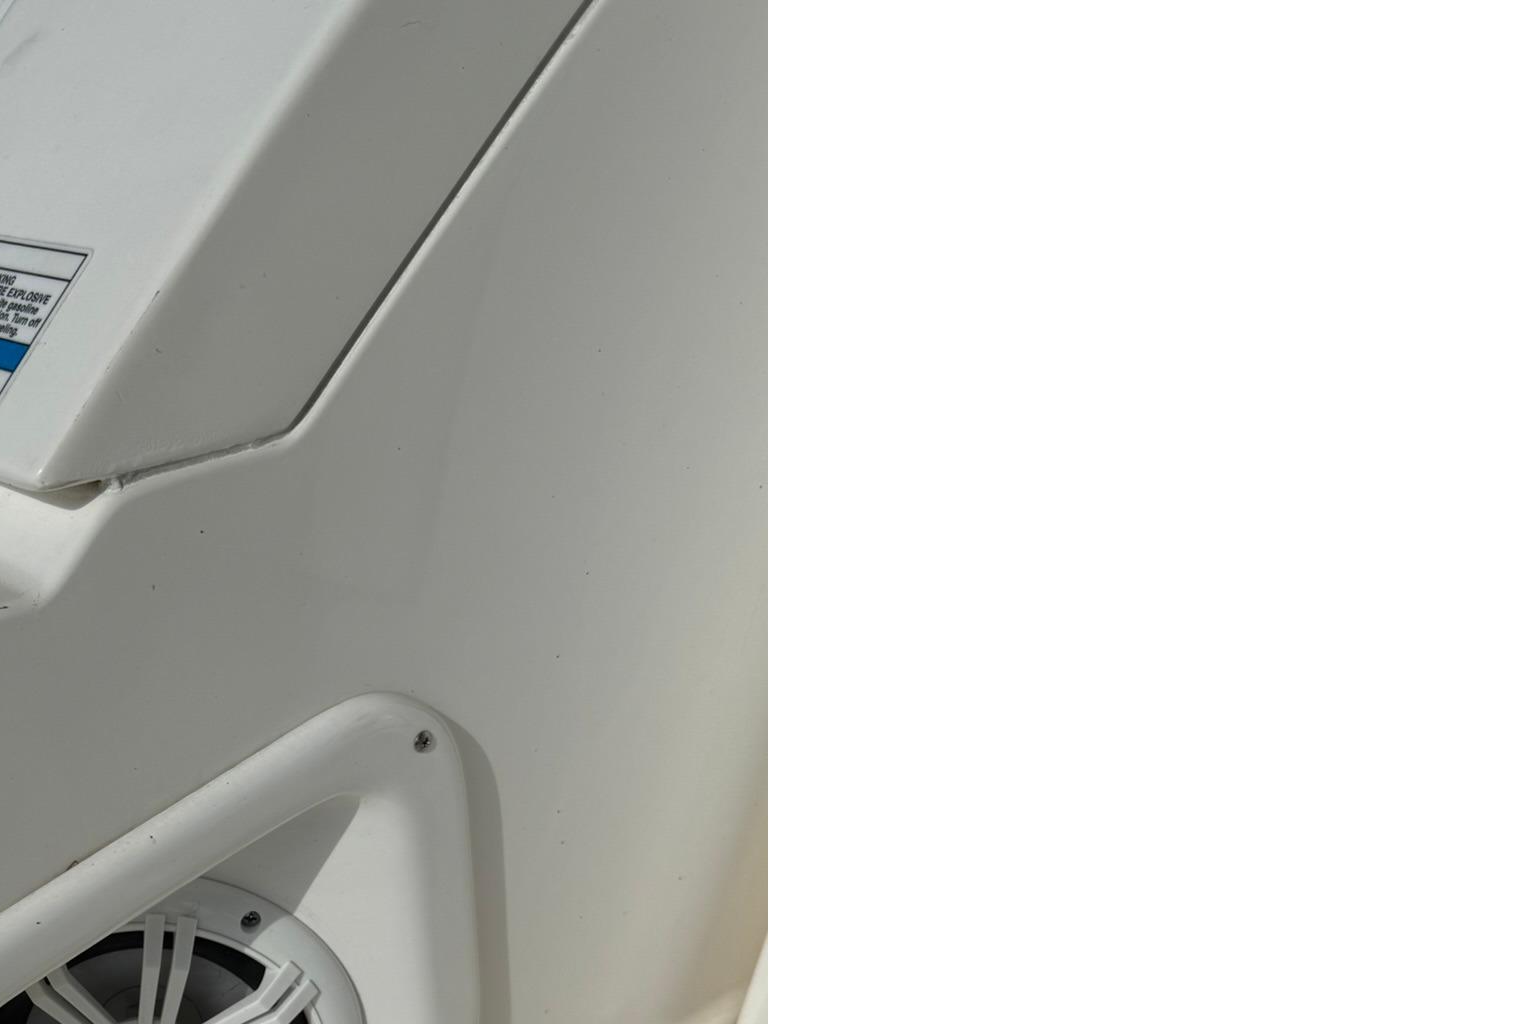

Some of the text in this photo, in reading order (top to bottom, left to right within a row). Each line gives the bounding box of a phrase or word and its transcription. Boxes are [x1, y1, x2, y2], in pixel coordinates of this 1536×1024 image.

[7, 287, 52, 305] EXPLOSIVE
[7, 301, 40, 316] gasoline
[11, 312, 29, 326] Turn
[28, 317, 43, 329] off
